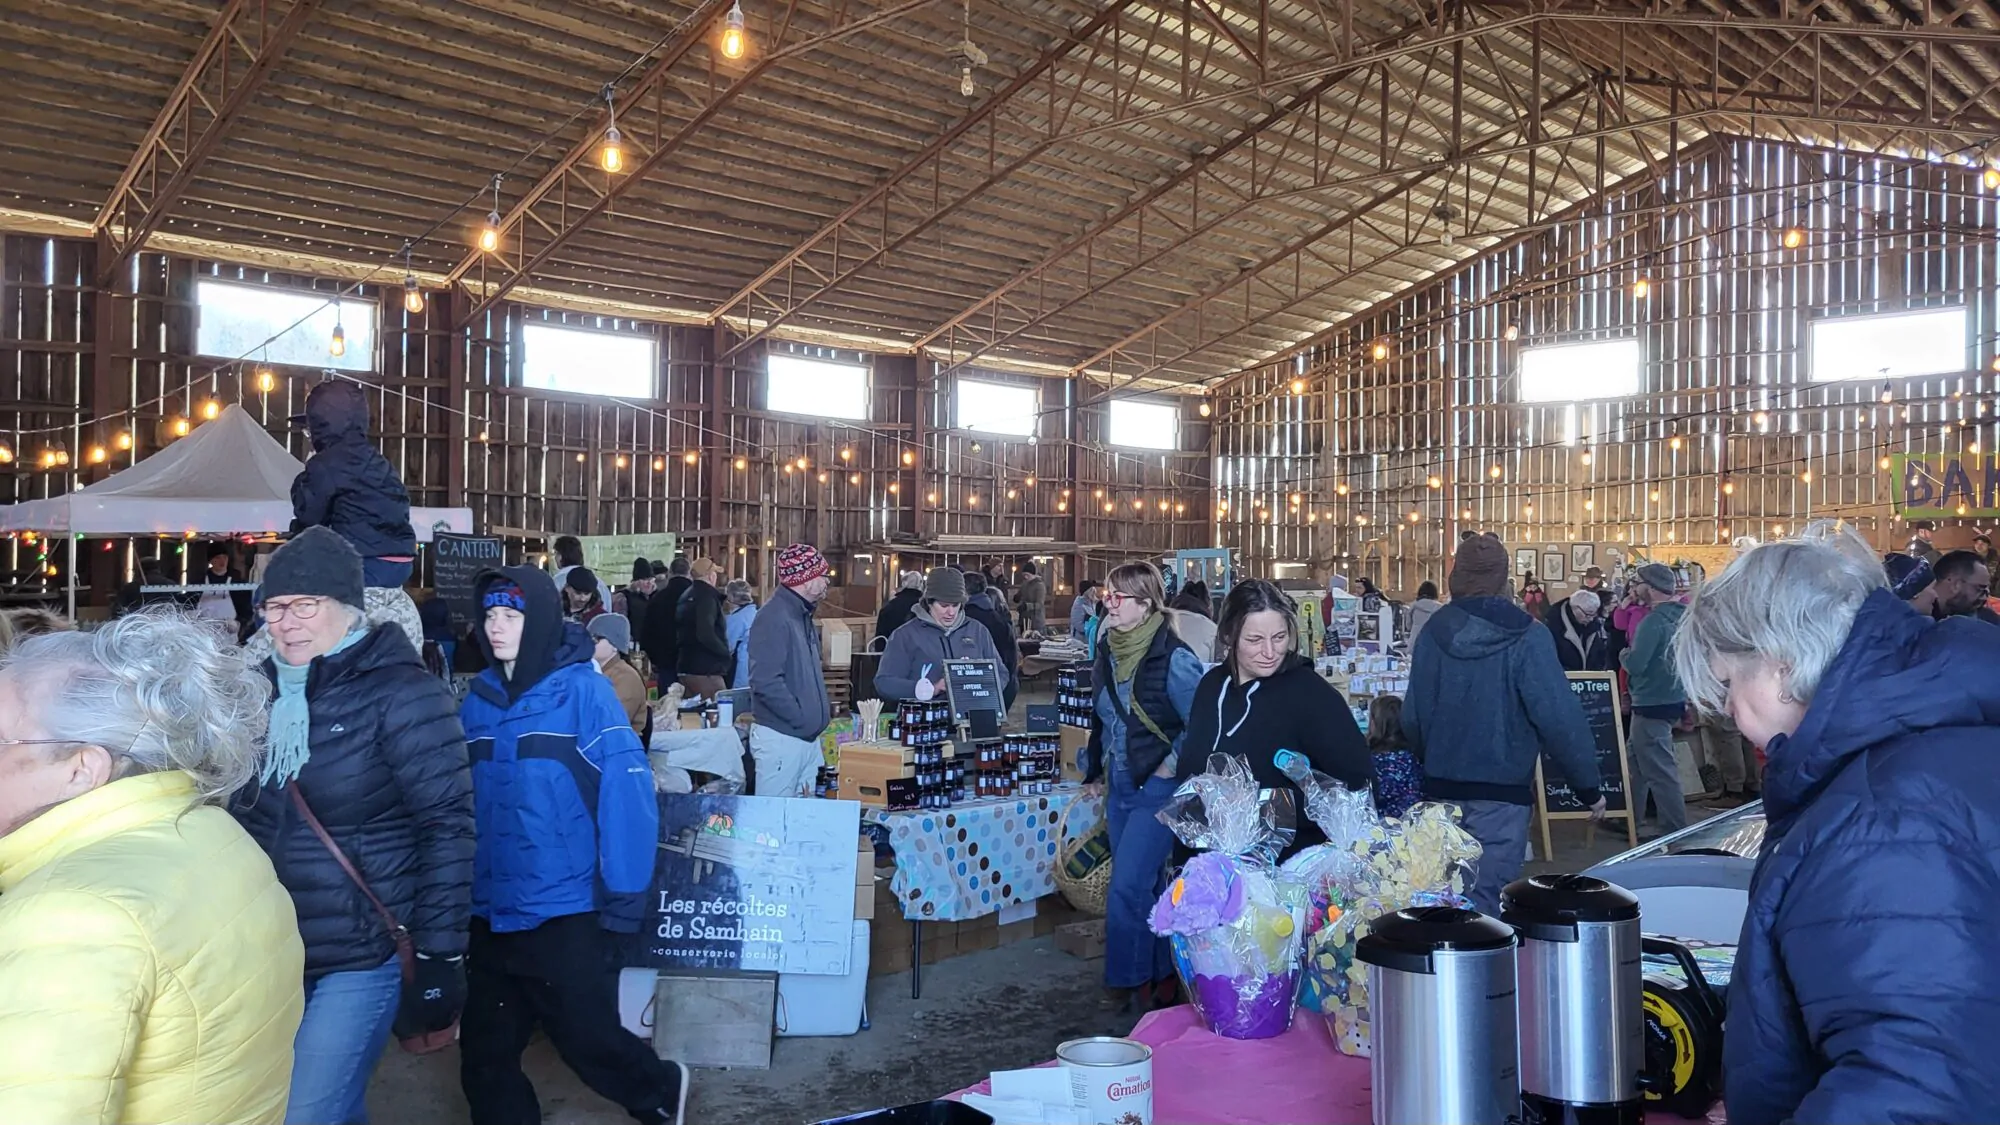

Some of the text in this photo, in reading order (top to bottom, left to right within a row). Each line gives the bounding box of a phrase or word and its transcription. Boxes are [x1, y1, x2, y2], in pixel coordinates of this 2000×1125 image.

[438, 539, 500, 559] CANTEEN
[1571, 680, 1610, 694] ap Tree
[1599, 781, 1623, 793] atural
[657, 890, 788, 918] Les récoltes
[657, 916, 784, 943] de Samhain
[657, 947, 780, 960] conserverie locale
[1647, 1019, 1667, 1041] NOMA
[1107, 1079, 1151, 1102] Carnation
